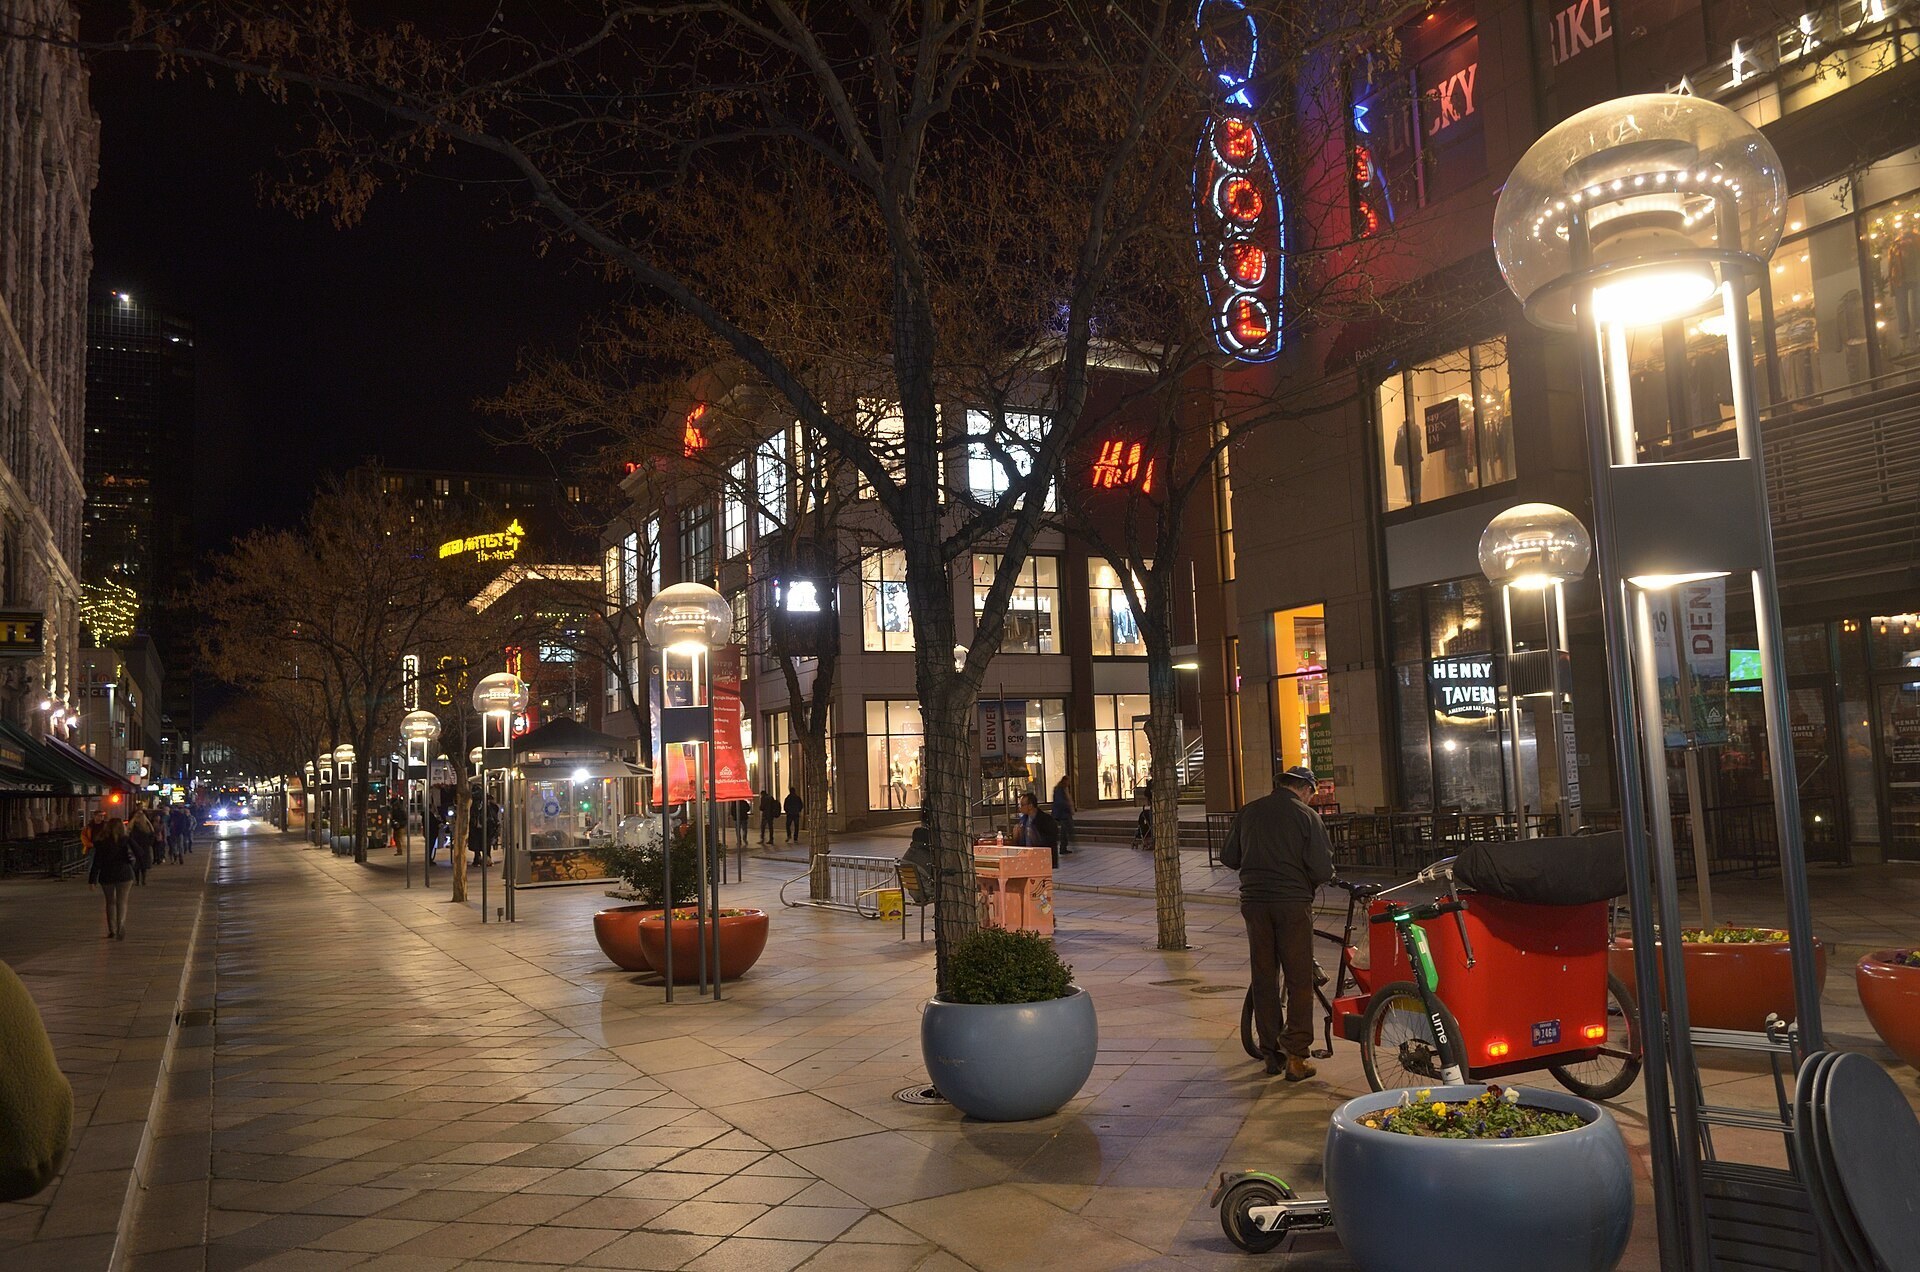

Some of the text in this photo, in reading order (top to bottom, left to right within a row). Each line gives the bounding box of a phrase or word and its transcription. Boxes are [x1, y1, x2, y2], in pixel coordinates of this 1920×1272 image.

[1549, 0, 1613, 67] IKE
[1442, 686, 1496, 706] TAVERN
[986, 705, 997, 751] DENVER
[1007, 735, 1024, 743] SC19
